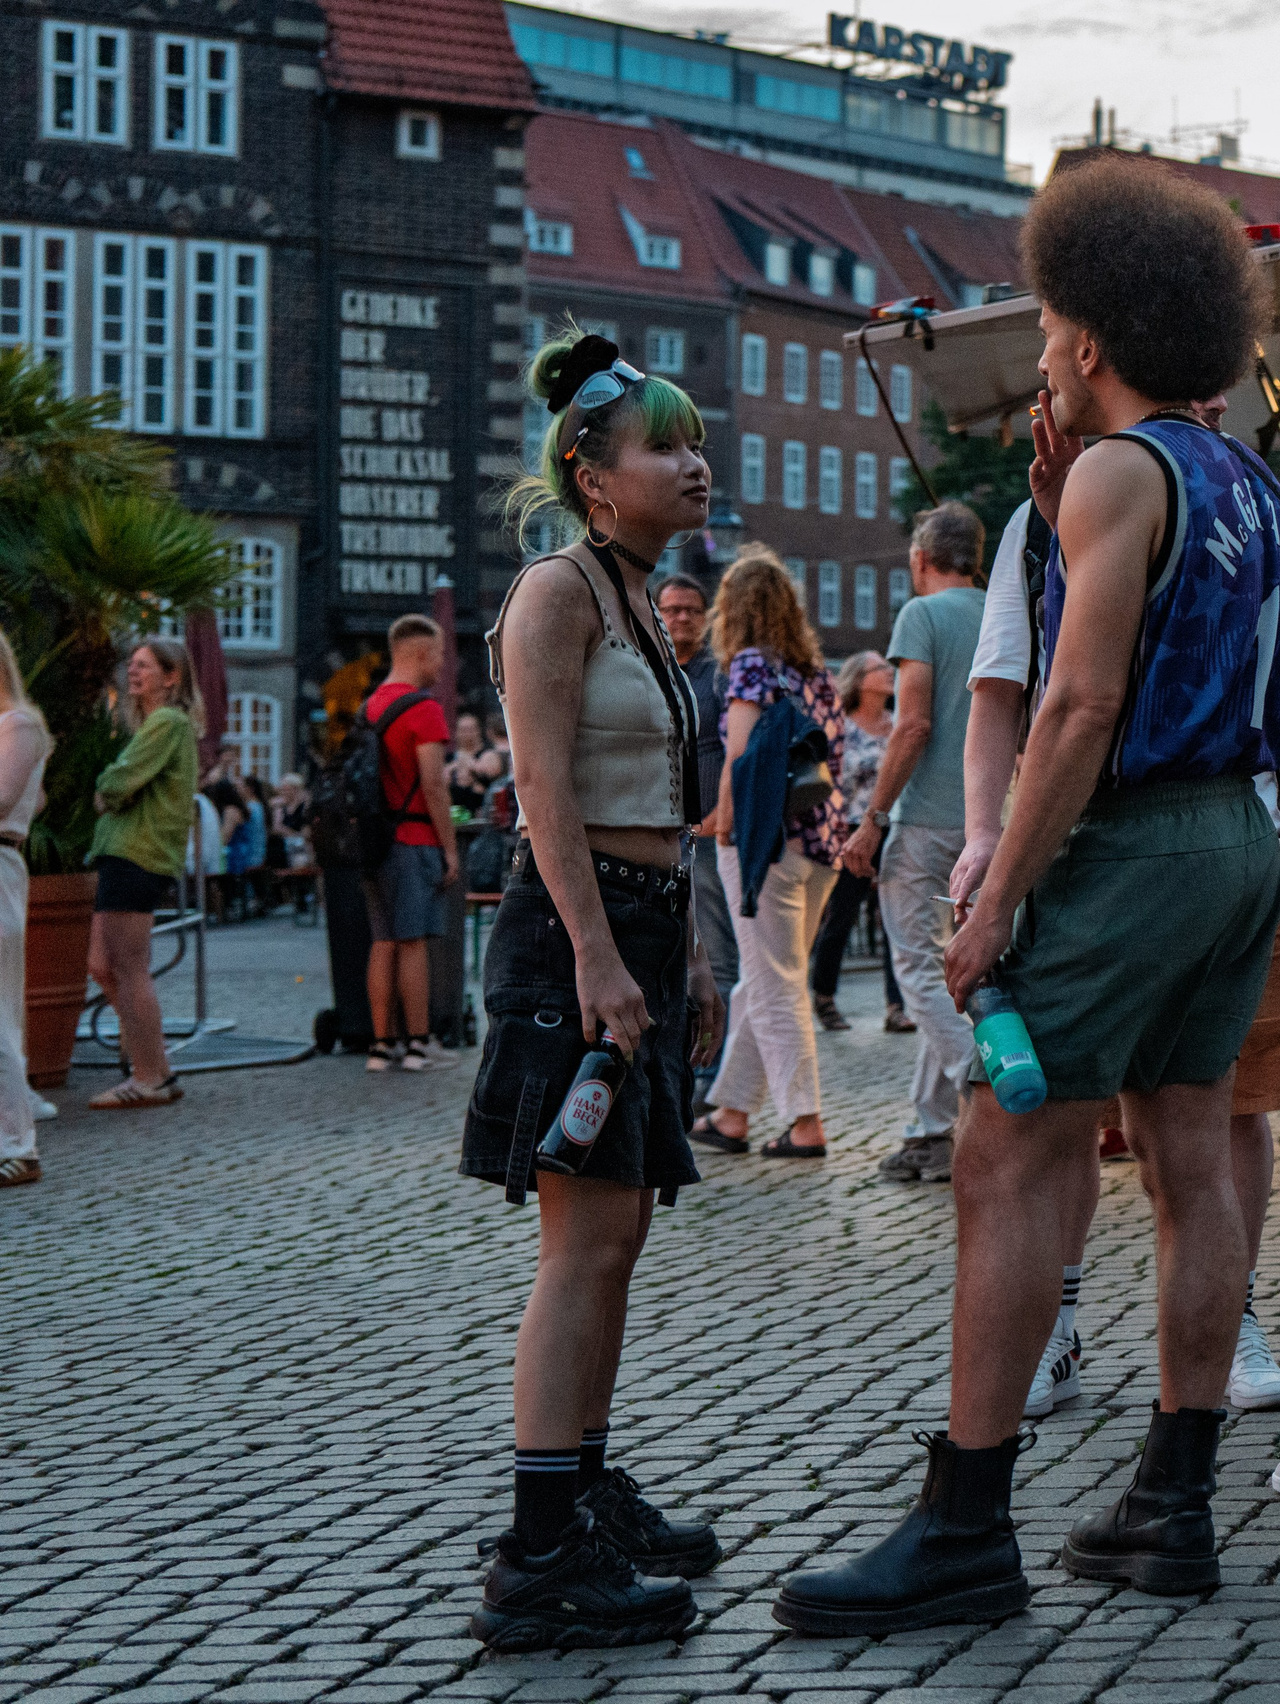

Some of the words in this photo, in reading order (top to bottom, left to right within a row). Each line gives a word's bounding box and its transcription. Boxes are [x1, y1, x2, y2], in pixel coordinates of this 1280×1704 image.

[827, 12, 1013, 87] KARSTADT
[573, 1108, 599, 1129] BECK
[574, 1096, 606, 1119] HAAKE
